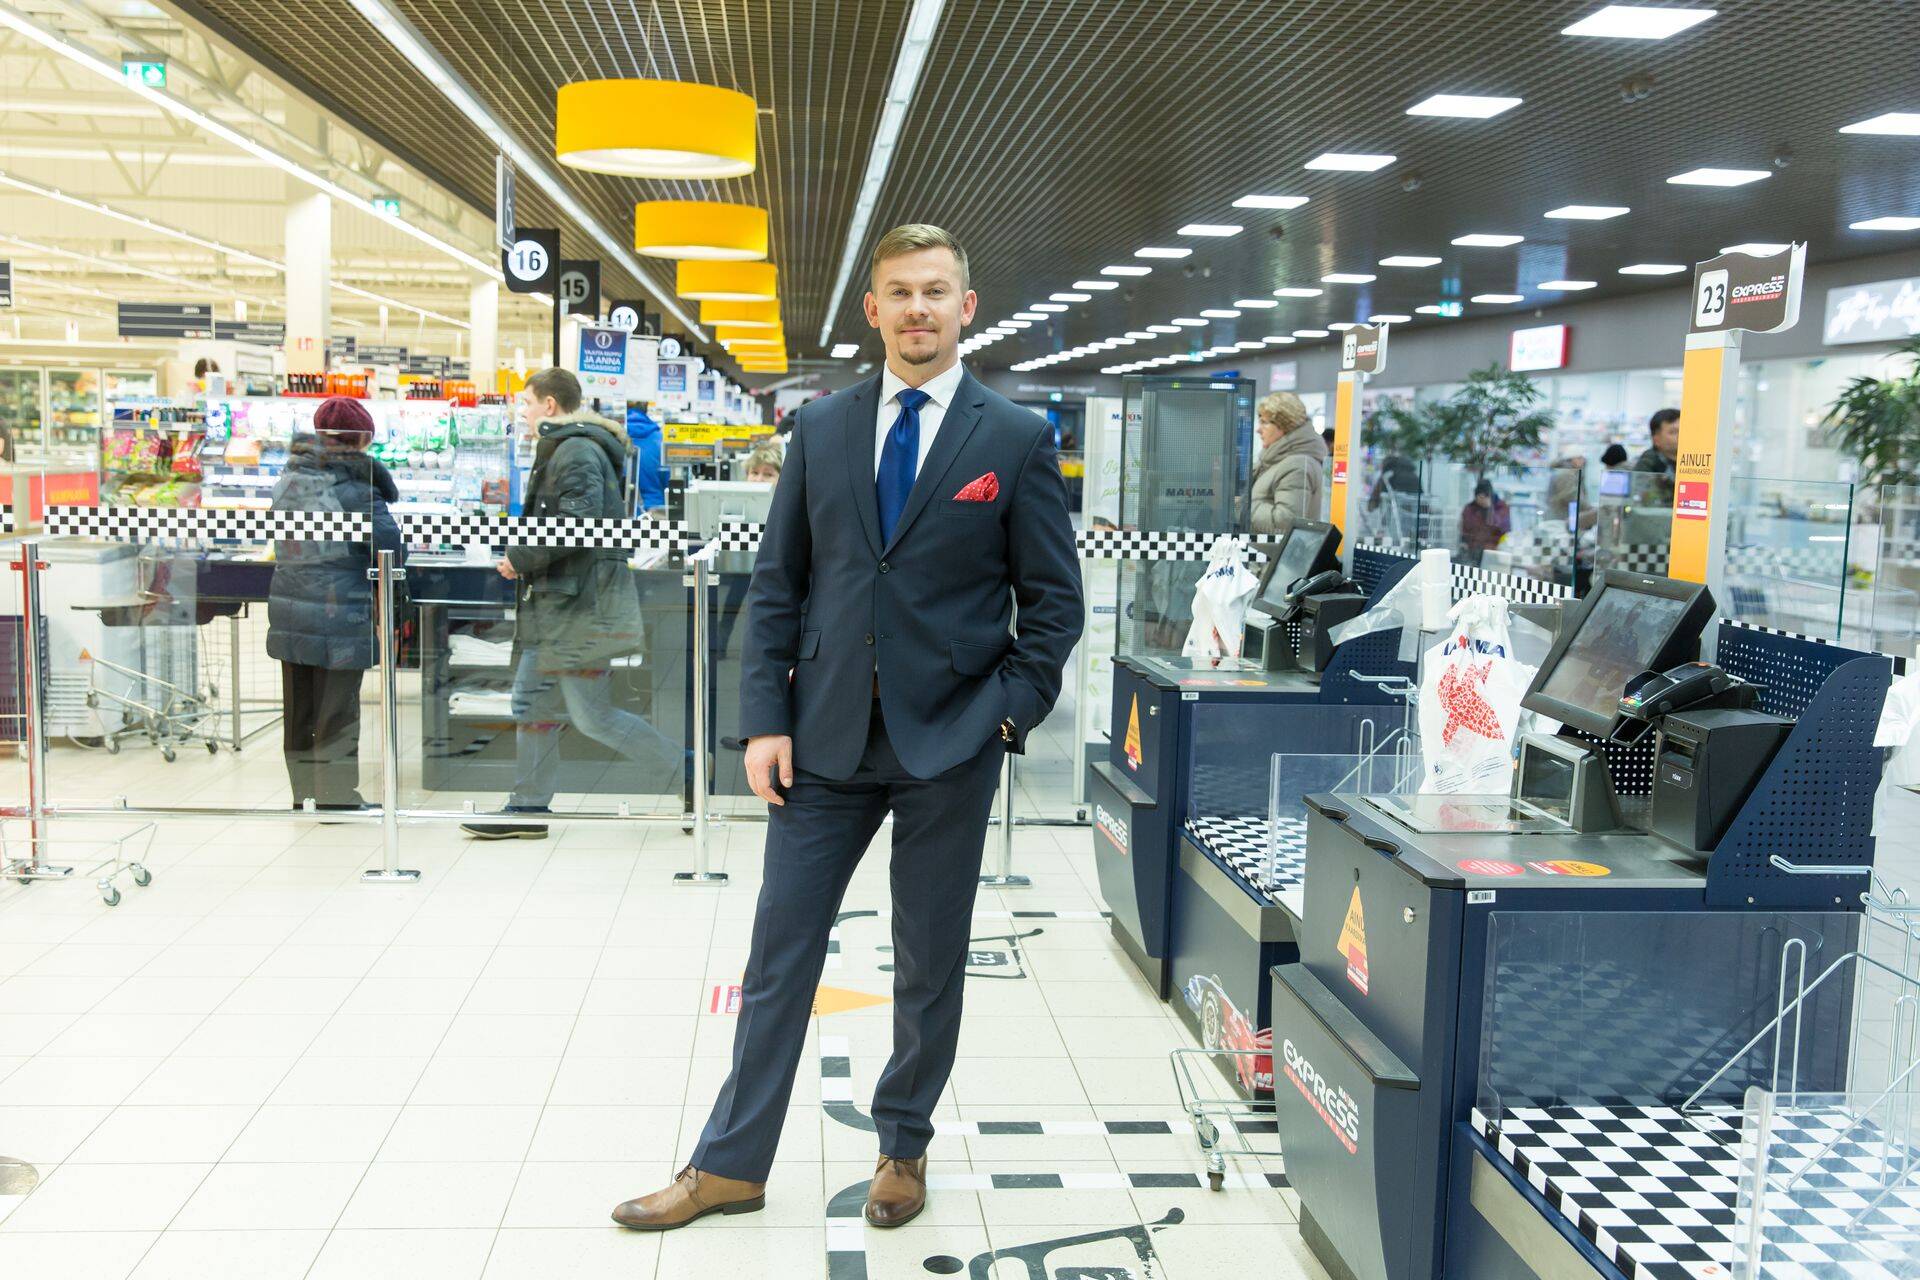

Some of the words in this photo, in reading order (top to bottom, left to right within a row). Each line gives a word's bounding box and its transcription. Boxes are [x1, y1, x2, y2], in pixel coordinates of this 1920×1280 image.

[515, 250, 541, 271] 16
[562, 279, 585, 298] 15
[1731, 280, 1785, 298] EXPRESS
[1702, 283, 1725, 314] 23
[595, 356, 621, 366] ANNA
[1680, 453, 1712, 467] AINULT
[1165, 487, 1216, 498] MAXIMA
[1096, 804, 1128, 848] EXPRESS
[971, 952, 996, 964] 22
[1283, 1038, 1359, 1142] EXPRESS
